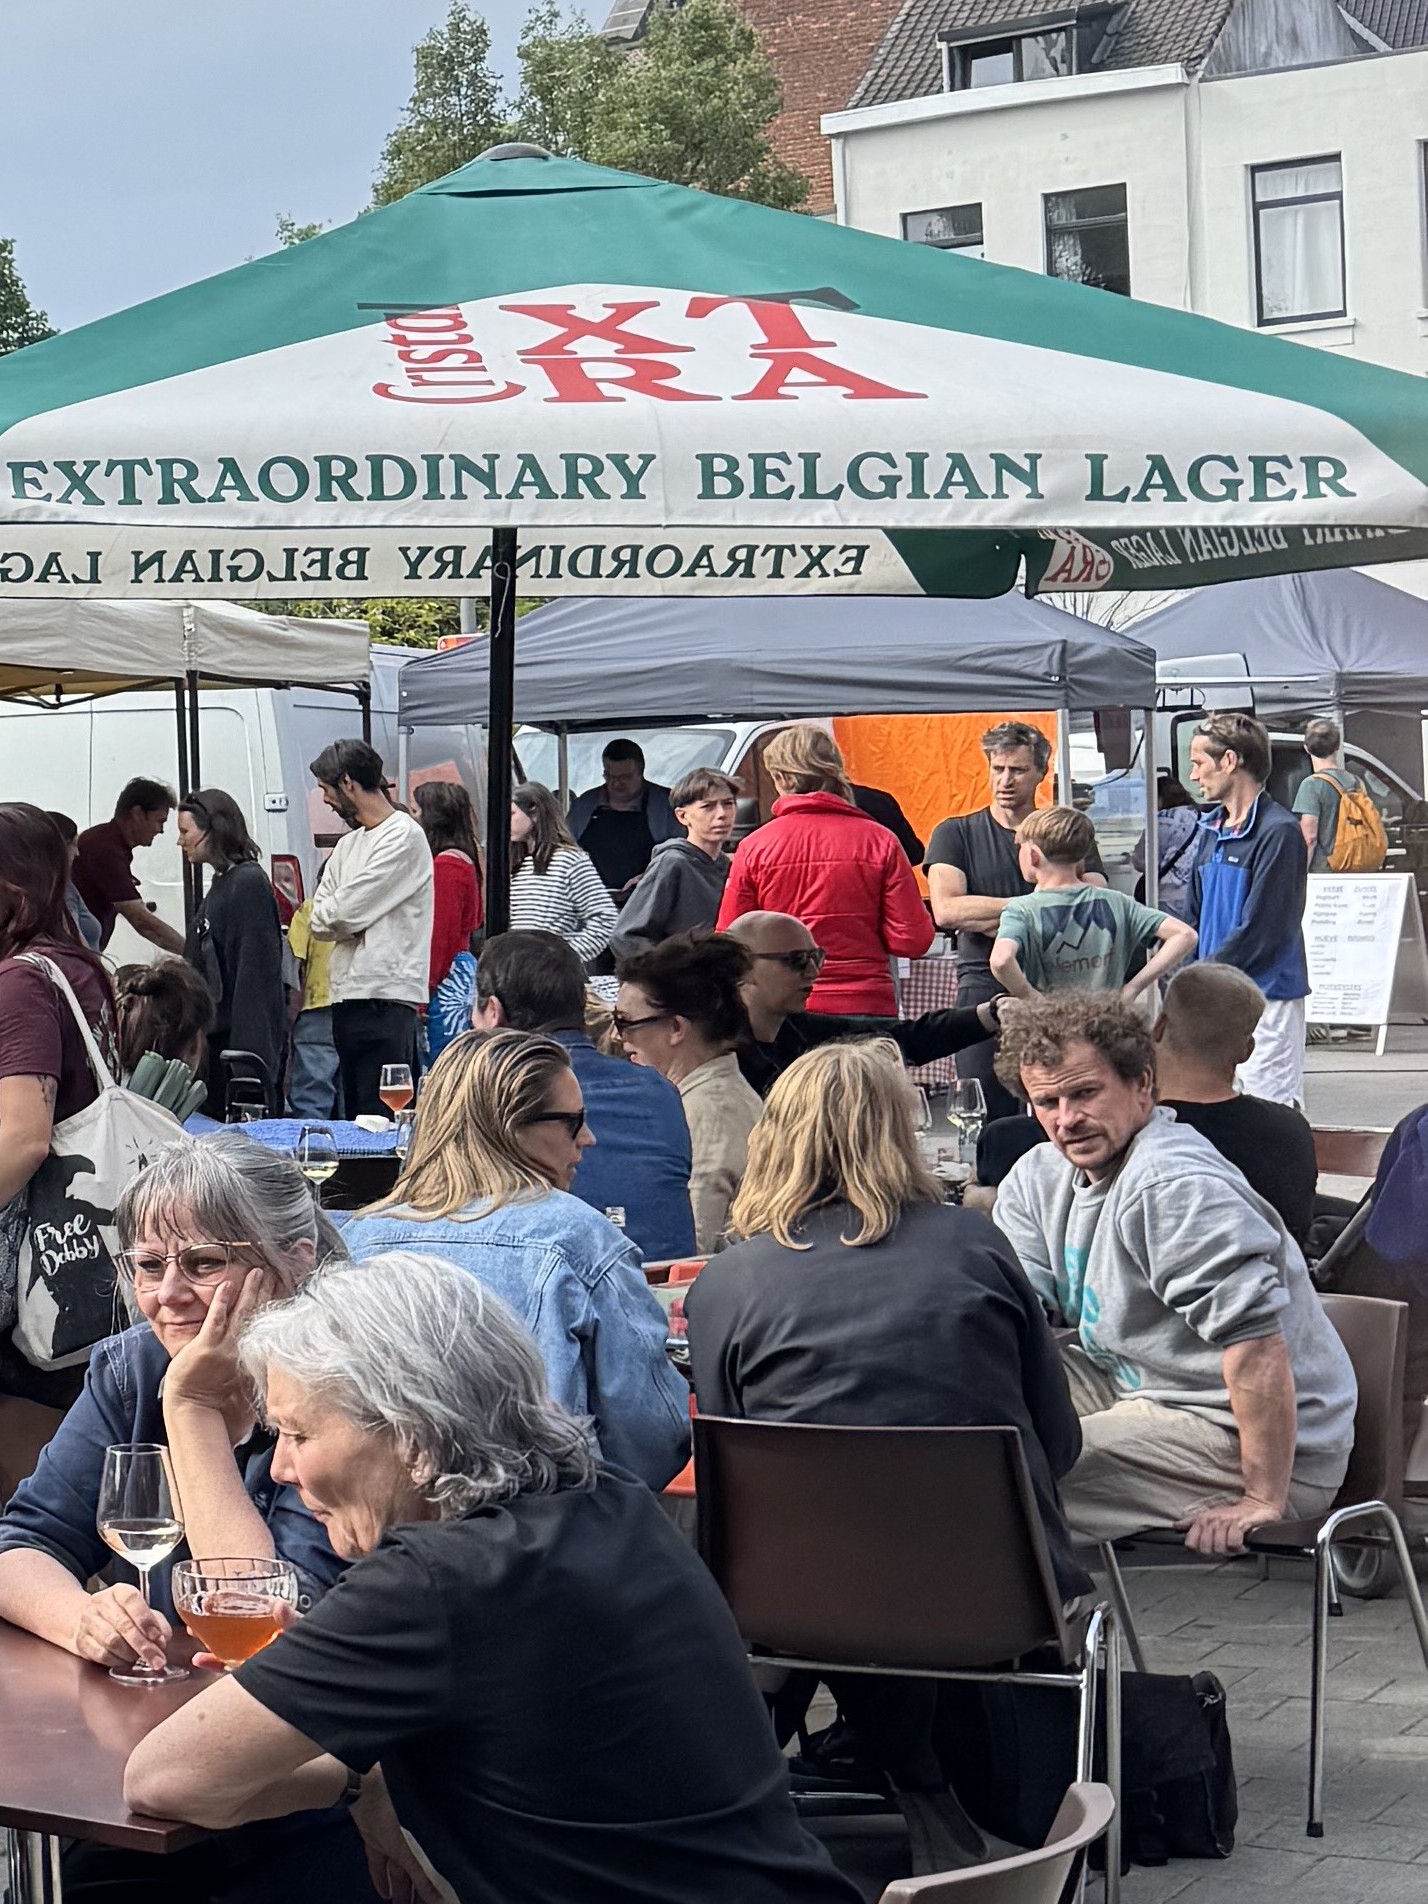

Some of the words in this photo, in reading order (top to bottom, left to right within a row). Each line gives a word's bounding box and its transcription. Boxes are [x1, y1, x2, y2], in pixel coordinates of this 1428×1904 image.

[6, 453, 657, 505] EXTRAORDINARY
[695, 451, 1044, 500] BELGIAN
[1084, 453, 1356, 503] LAGER
[34, 1214, 91, 1251] Free
